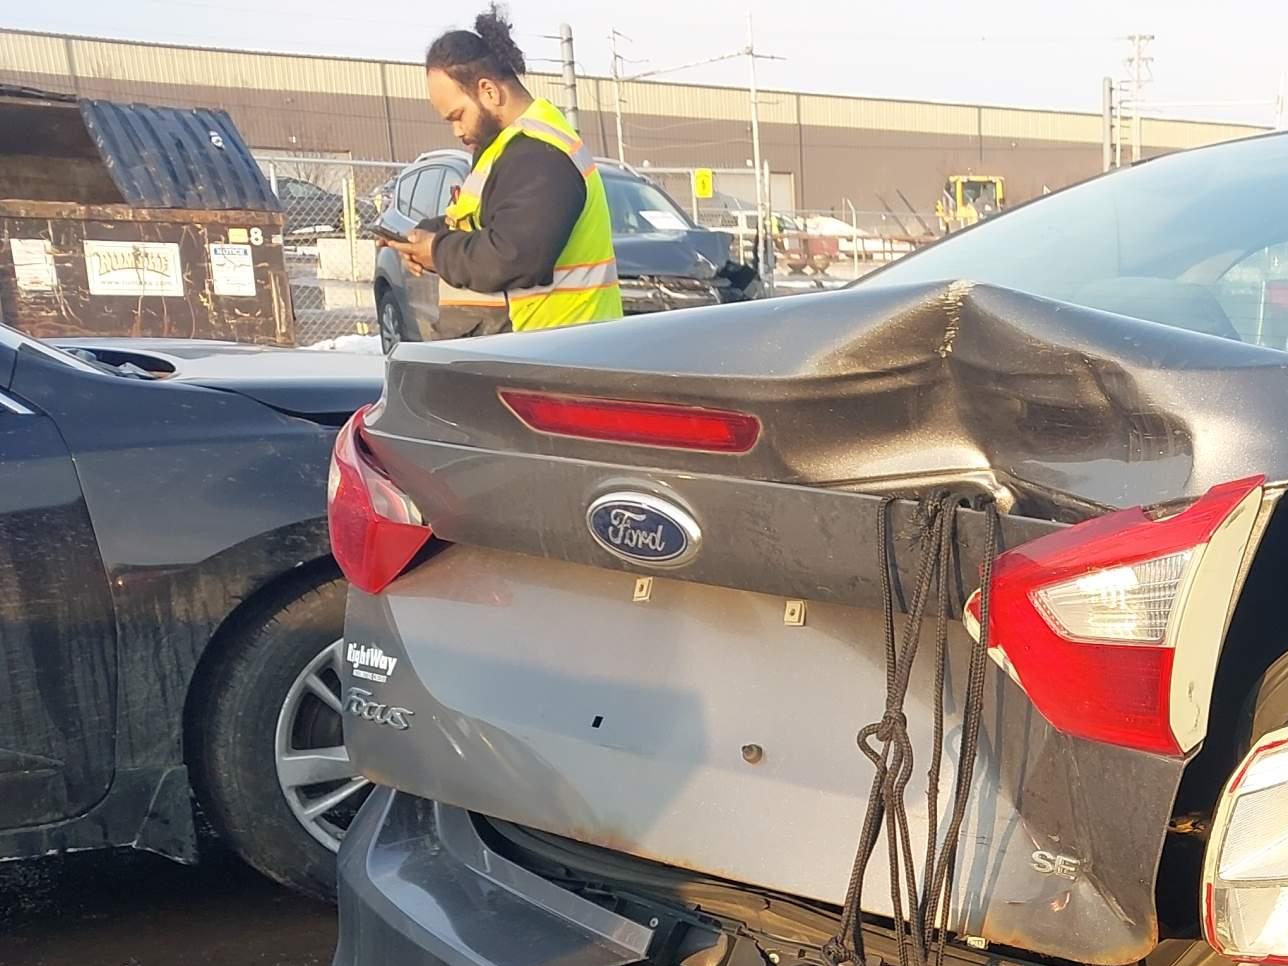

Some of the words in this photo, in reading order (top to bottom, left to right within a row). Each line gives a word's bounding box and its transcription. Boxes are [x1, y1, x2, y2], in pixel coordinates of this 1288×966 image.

[250, 227, 264, 246] 8
[608, 509, 665, 551] Ford
[346, 642, 398, 676] RightWay
[344, 687, 415, 731] Focus
[1031, 850, 1081, 880] SE
